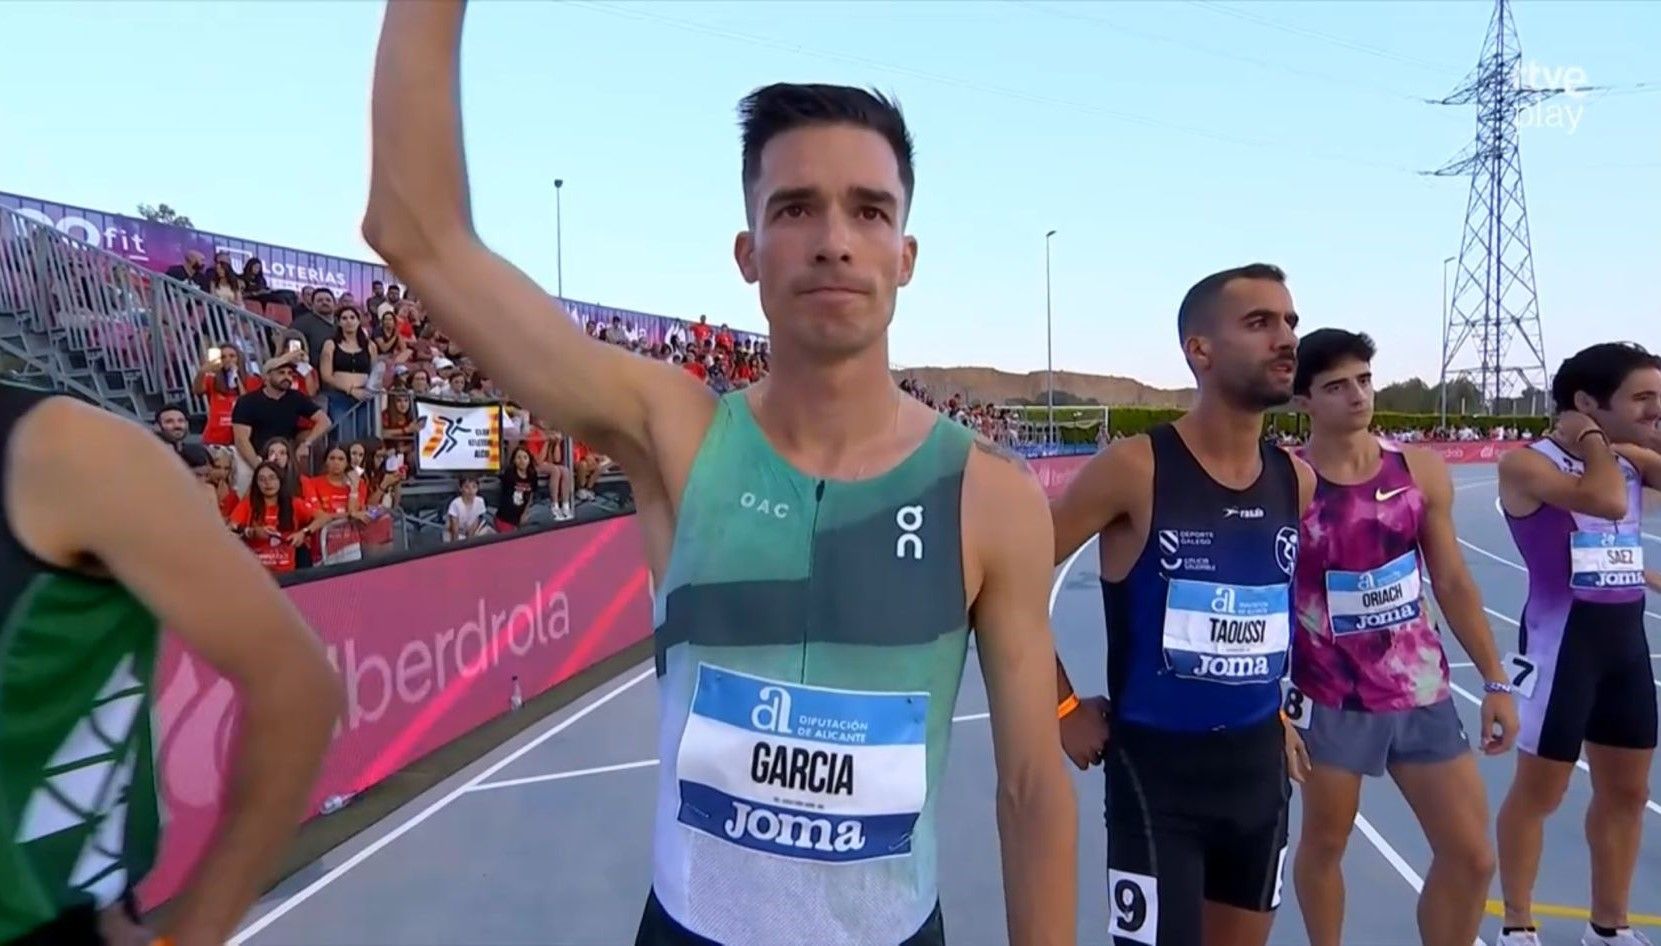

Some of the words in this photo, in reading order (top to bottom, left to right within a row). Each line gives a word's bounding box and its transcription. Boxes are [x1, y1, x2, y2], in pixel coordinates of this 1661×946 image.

[264, 261, 346, 286] LOTERÍAS
[740, 492, 789, 518] OAC
[1607, 549, 1634, 565] SAEZ
[1362, 583, 1403, 608] ORIACH
[1209, 618, 1266, 644] TAOUSSI
[1512, 658, 1534, 687] 7
[1284, 687, 1304, 721] 8
[797, 726, 812, 738] DE
[815, 728, 867, 744] ALICANTE
[799, 714, 869, 731] DIPUTACIÓN
[751, 741, 854, 796] GARCIA
[1114, 879, 1147, 933] 9
